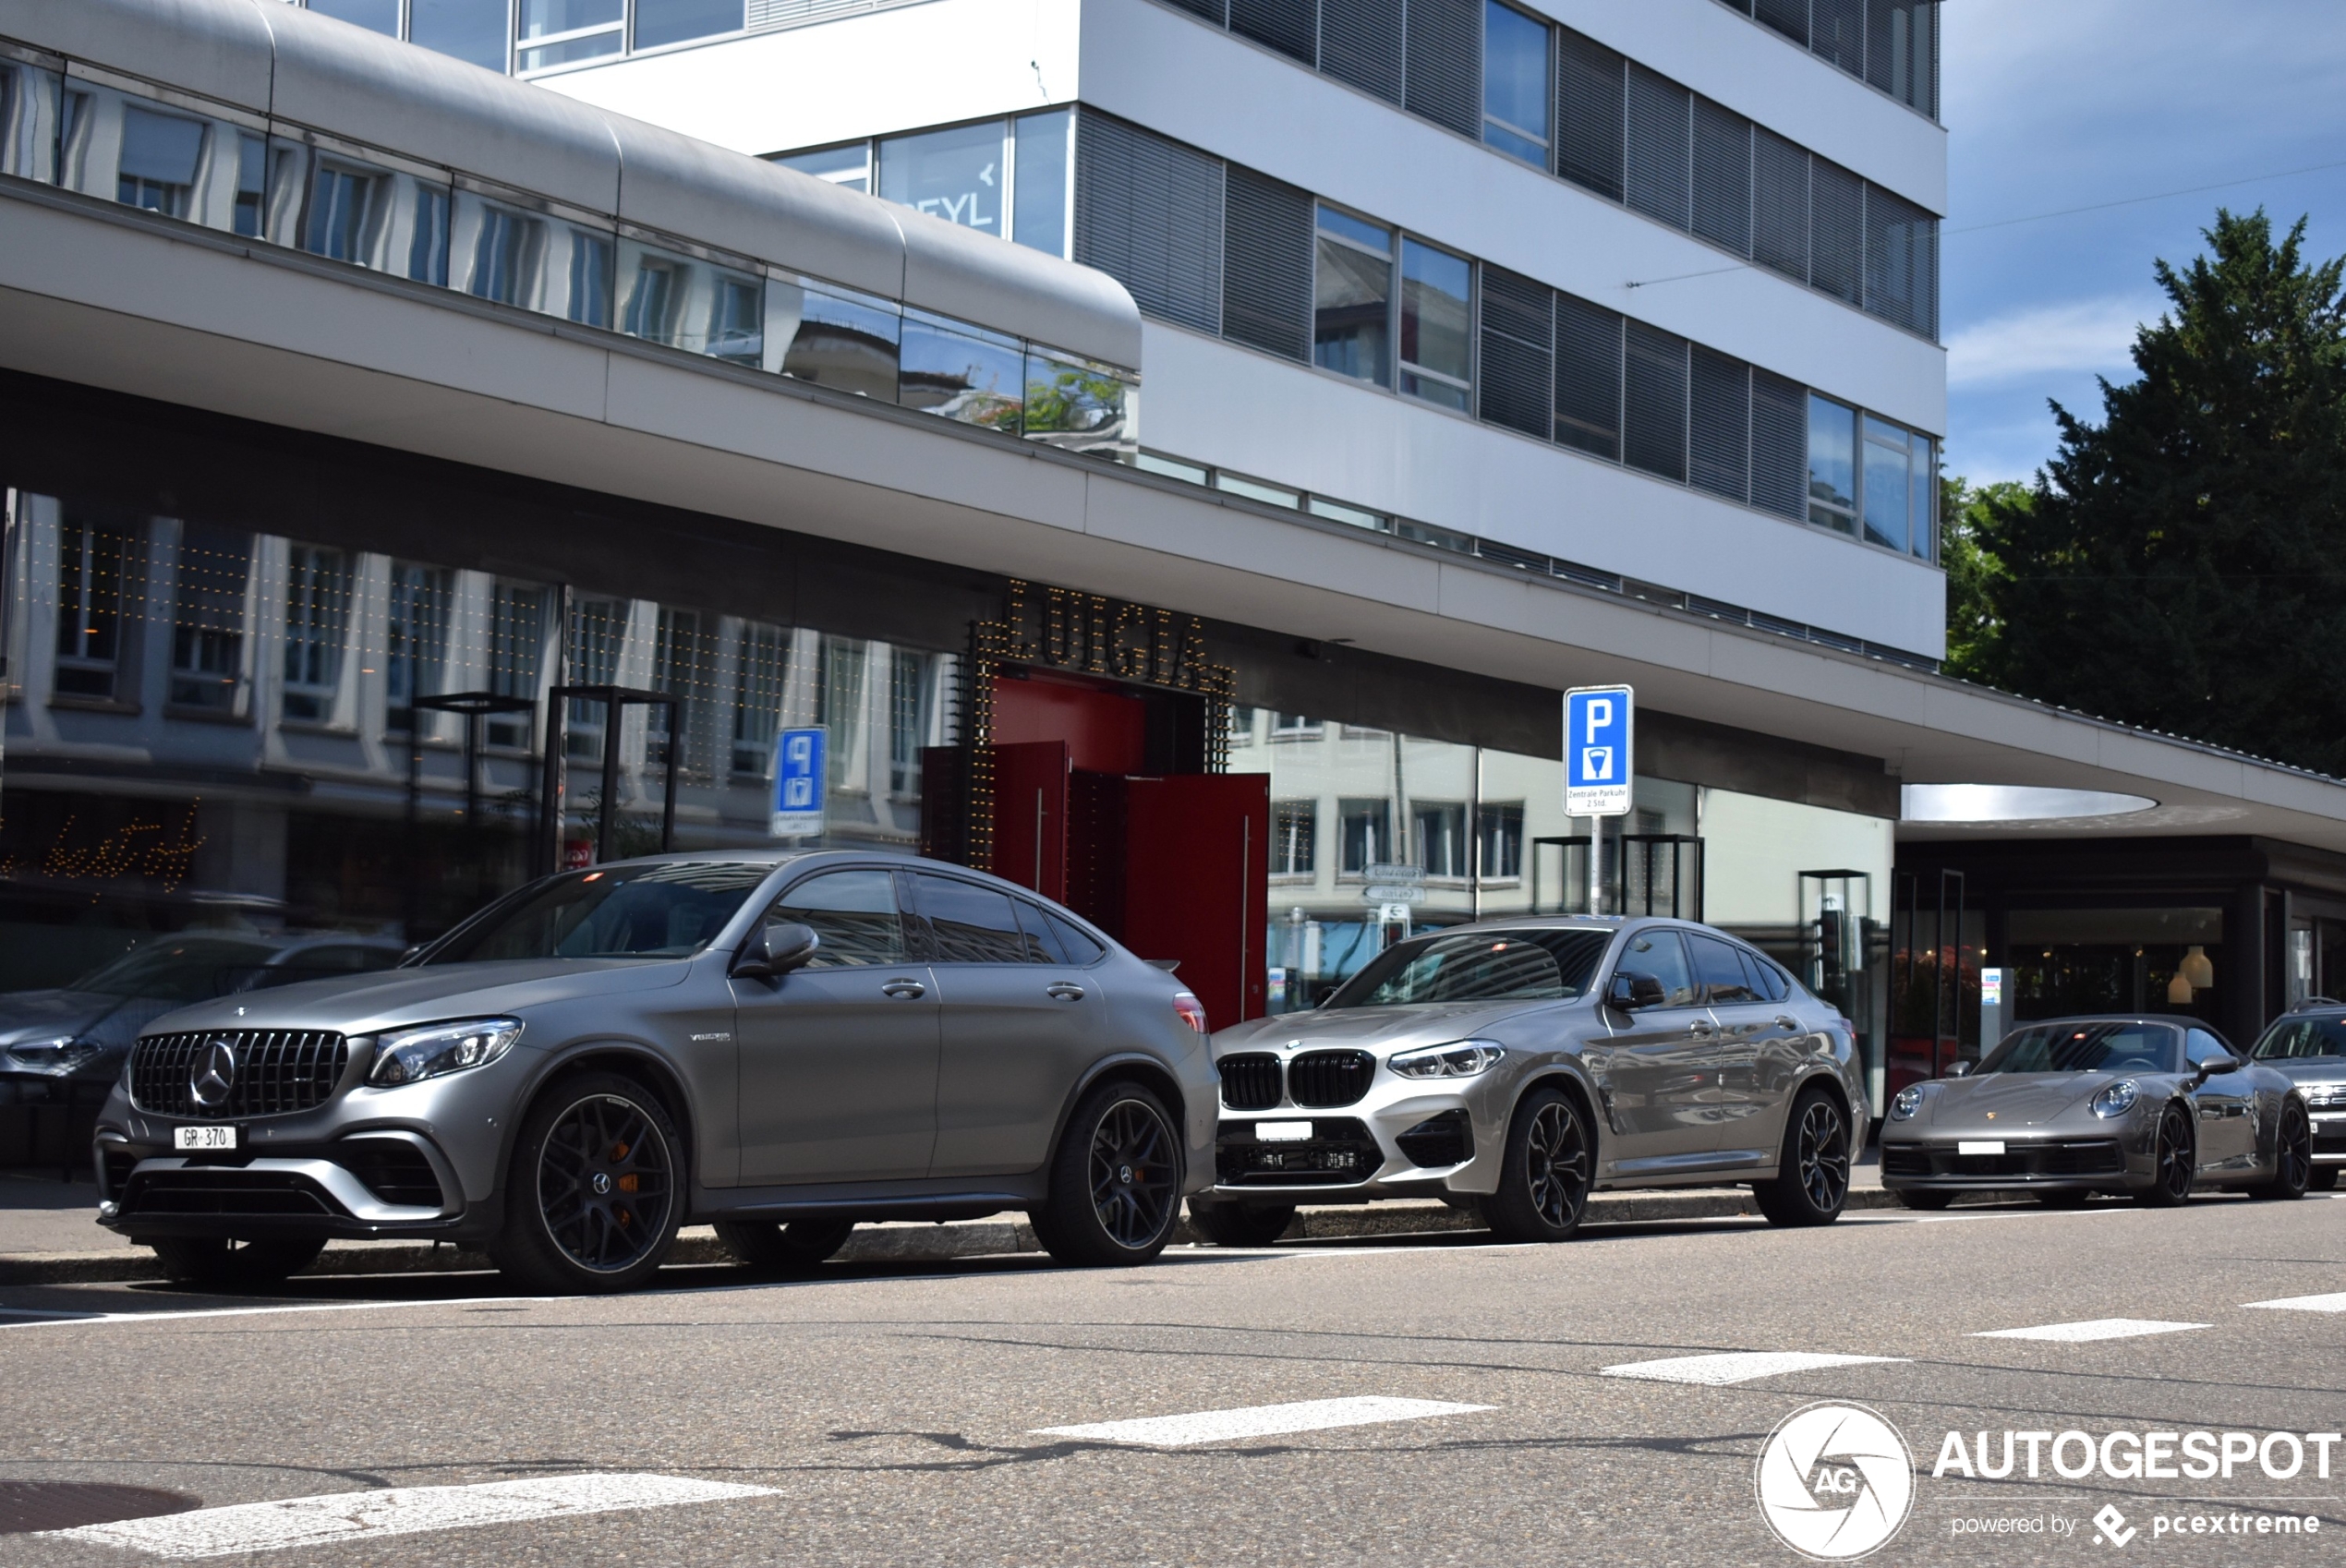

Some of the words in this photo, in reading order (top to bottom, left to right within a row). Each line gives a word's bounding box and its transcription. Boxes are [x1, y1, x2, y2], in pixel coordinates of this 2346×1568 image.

[1008, 579, 1211, 691] LUIGIA
[1587, 698, 1613, 744] P
[1568, 790, 1597, 798] Zentrale
[1600, 789, 1626, 797] Parkuhr
[184, 1128, 199, 1147] GR
[205, 1128, 226, 1146] 370
